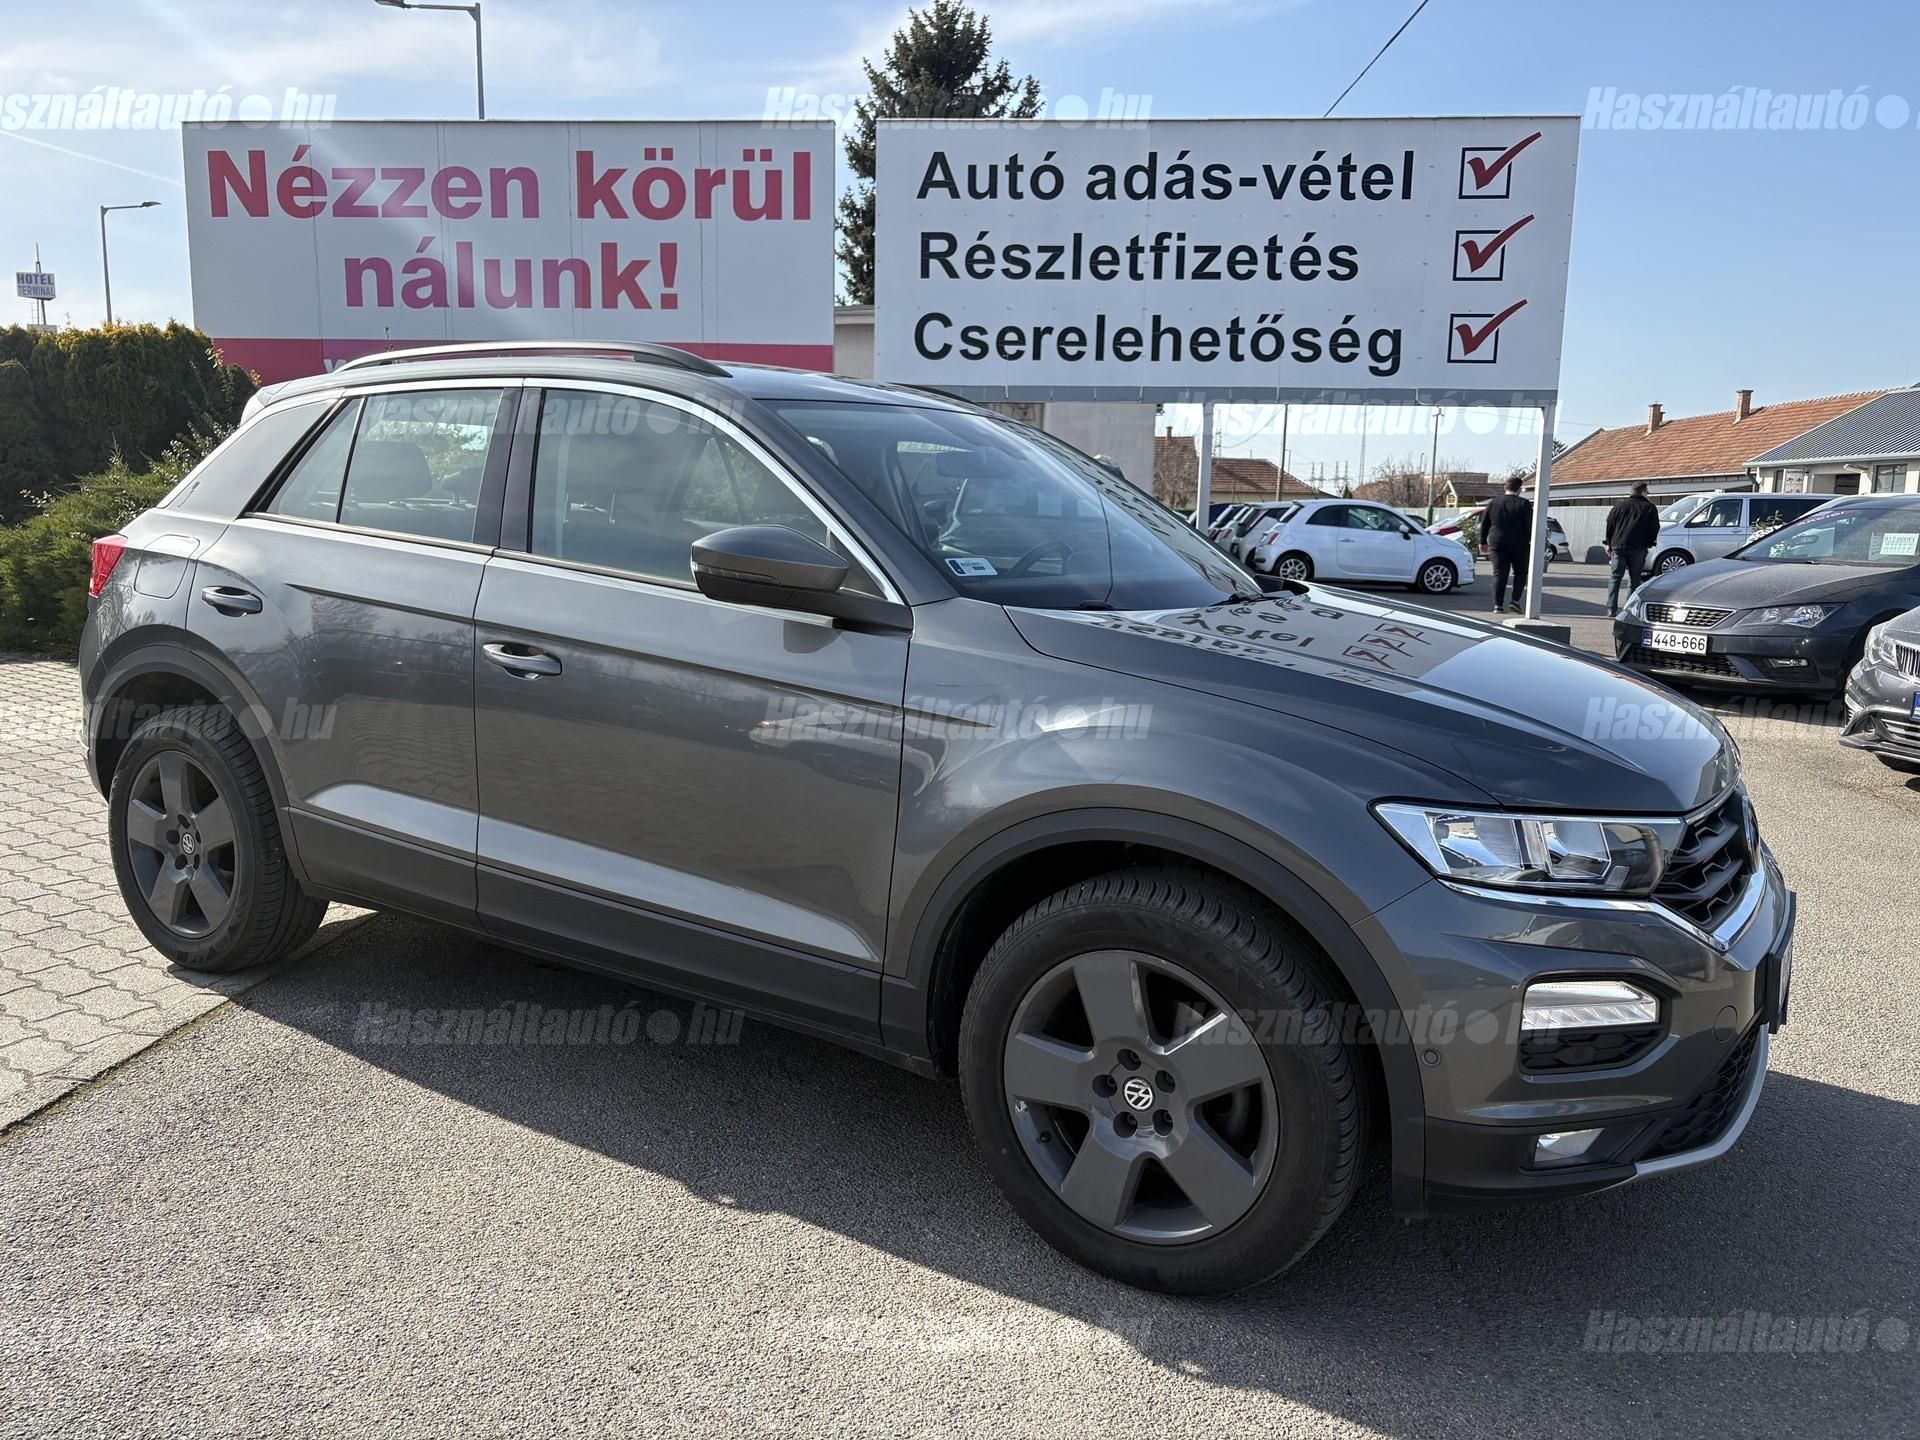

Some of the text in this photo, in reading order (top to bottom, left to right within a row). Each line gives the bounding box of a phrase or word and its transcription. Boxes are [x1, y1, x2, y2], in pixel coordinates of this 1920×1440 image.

[208, 148, 812, 221] Nézzen körül
[916, 150, 1415, 201] Autó adás-vétel
[17, 272, 55, 286] HOTEL
[345, 235, 679, 310] nálunk!
[919, 231, 1360, 282] Részletfizetés
[17, 285, 56, 297] TERMINAL
[914, 312, 1402, 377] Cserelehetőség
[1654, 633, 1706, 651] 448-666
